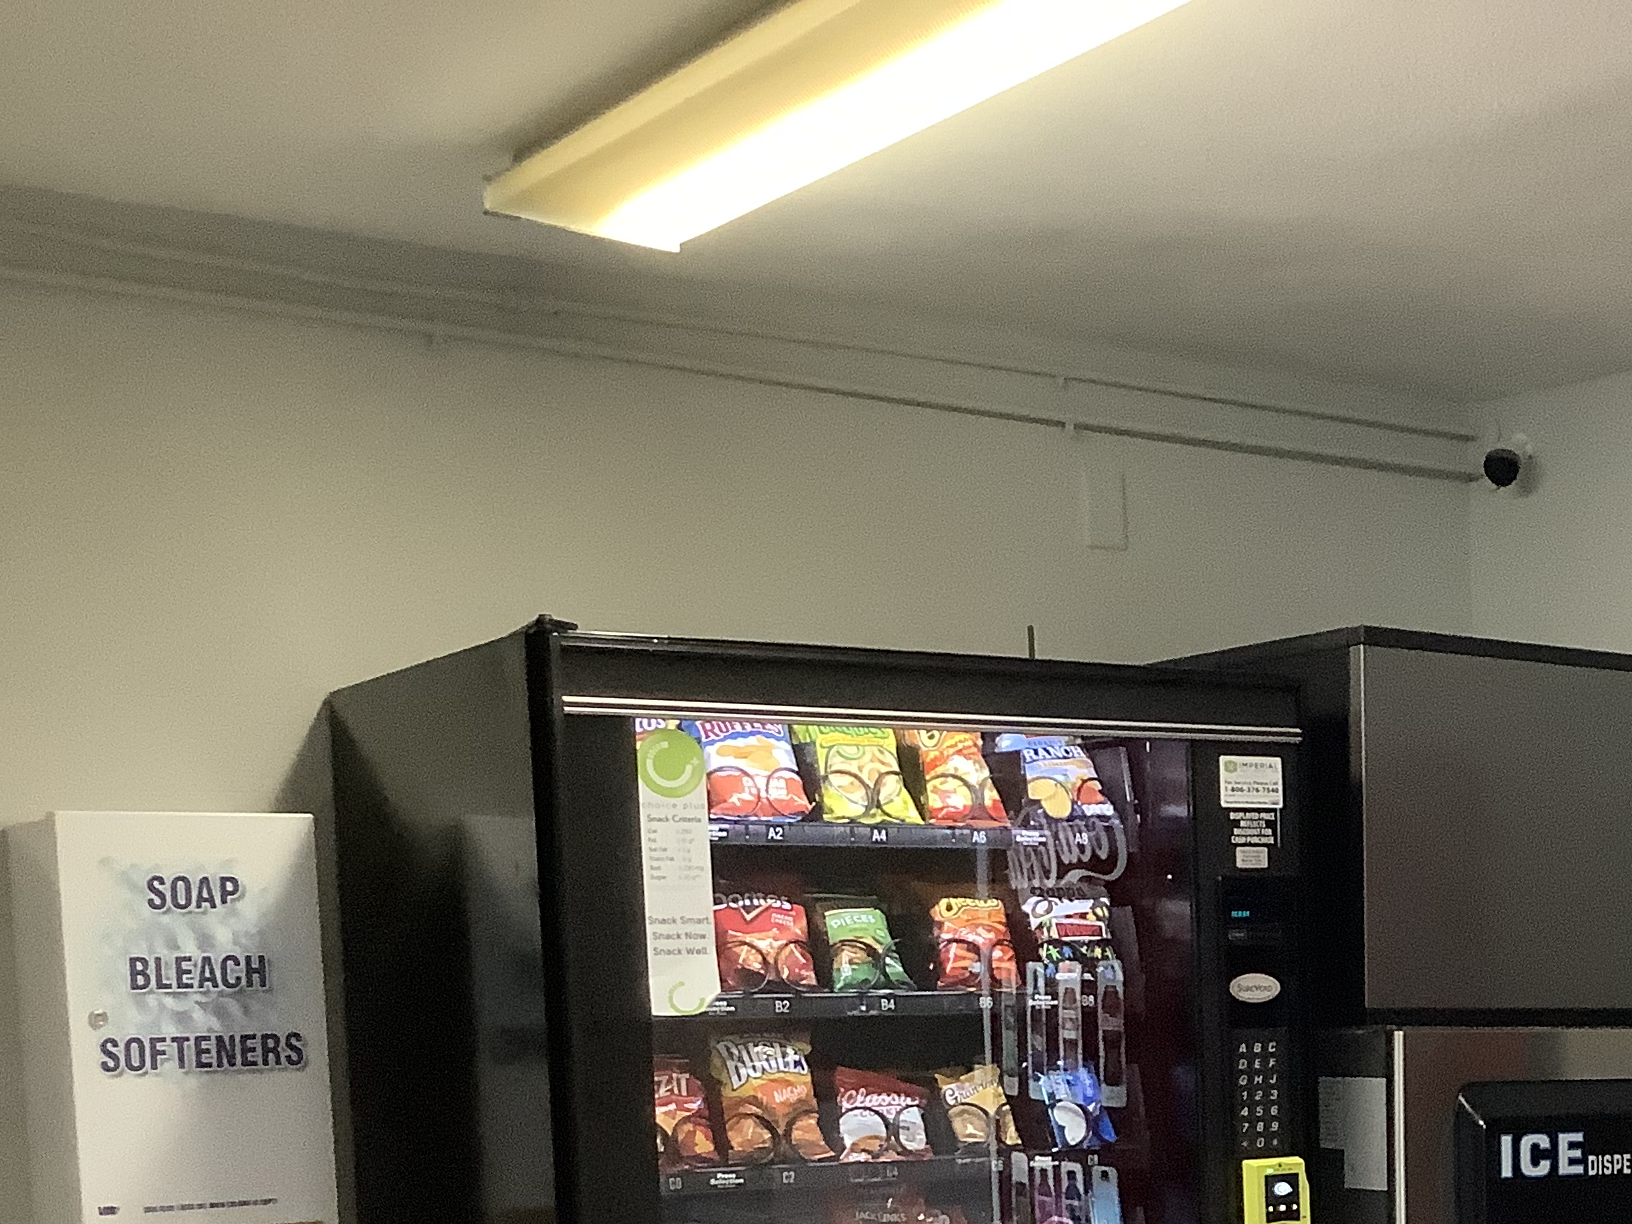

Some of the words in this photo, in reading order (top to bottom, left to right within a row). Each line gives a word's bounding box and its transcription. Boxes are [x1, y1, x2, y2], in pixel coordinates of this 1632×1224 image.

[1022, 746, 1085, 763] RANCH
[642, 802, 678, 810] choice
[683, 801, 705, 811] plus
[647, 814, 670, 823] Snack
[672, 814, 702, 823] Criteria
[767, 828, 783, 841] A2
[872, 830, 887, 842] A4
[972, 831, 987, 844] A6
[1074, 832, 1089, 845] A8
[147, 875, 240, 911] SOAP
[648, 915, 677, 925] Snack
[830, 915, 876, 929] PIECES
[652, 931, 682, 940] Snack
[653, 946, 682, 956] Snack
[128, 954, 268, 991] BLEACH
[775, 1000, 790, 1013] B2
[880, 998, 895, 1011] B4
[100, 1031, 305, 1073] SOFTENERS
[1239, 1043, 1247, 1052] A
[1254, 1042, 1262, 1052] B
[1268, 1042, 1276, 1052] C
[716, 1041, 810, 1091] BUGLES
[1239, 1059, 1247, 1069] D
[1254, 1059, 1261, 1068] E
[1269, 1058, 1276, 1068] F
[1239, 1075, 1247, 1085] G
[1254, 1075, 1263, 1084] H
[1269, 1074, 1277, 1084] J
[773, 1084, 807, 1103] NACHO
[1242, 1091, 1247, 1100] 1
[1255, 1091, 1263, 1100] 2
[1270, 1090, 1278, 1099] 3
[1241, 1107, 1248, 1116] 4
[1256, 1106, 1263, 1116] 5
[1271, 1106, 1278, 1115] 6
[1242, 1123, 1249, 1132] 7
[1256, 1122, 1264, 1131] 8
[1271, 1122, 1279, 1131] 9
[1501, 1132, 1584, 1179] ICE
